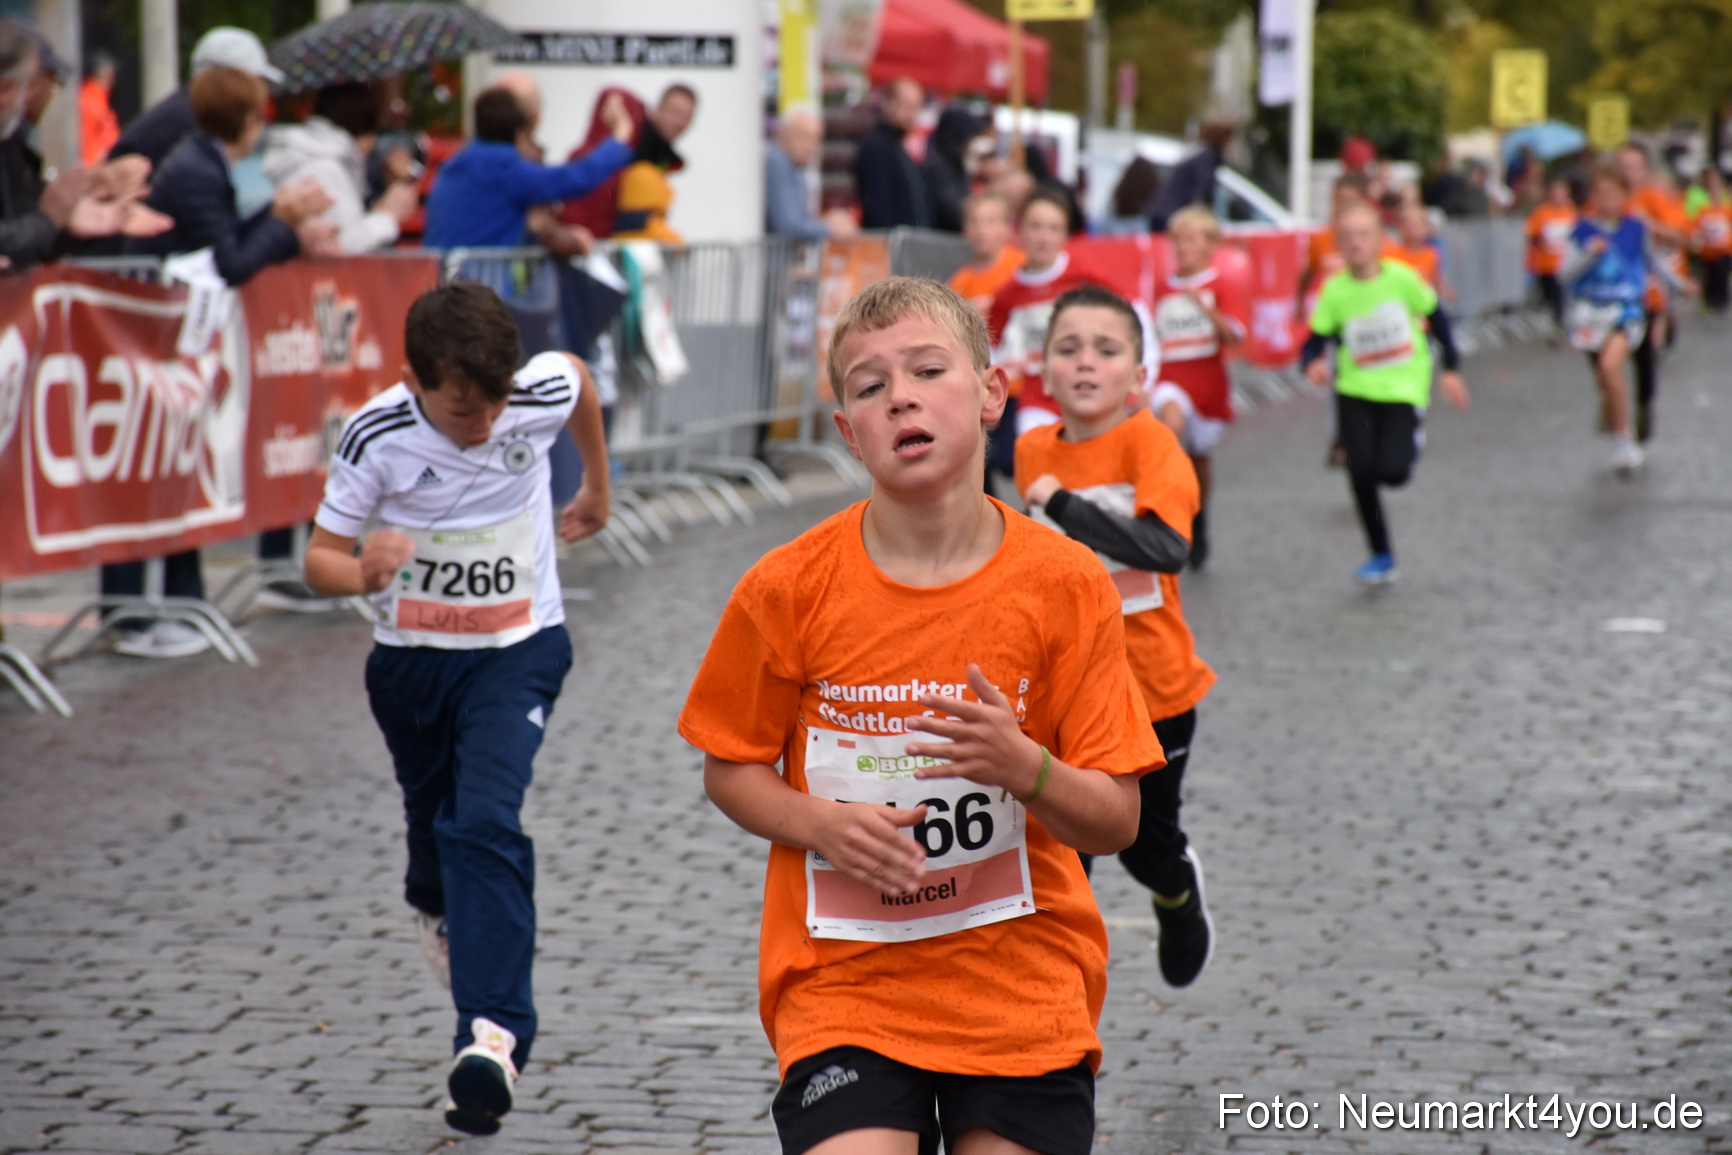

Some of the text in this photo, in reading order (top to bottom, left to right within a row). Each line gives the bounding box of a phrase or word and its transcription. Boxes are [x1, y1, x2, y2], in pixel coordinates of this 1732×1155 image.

[415, 556, 515, 597] 7266
[418, 605, 479, 633] LUIS
[814, 679, 968, 702] Neumarkter
[835, 792, 994, 858] 66
[881, 877, 957, 906] Marcel
[802, 1069, 859, 1108] adidas
